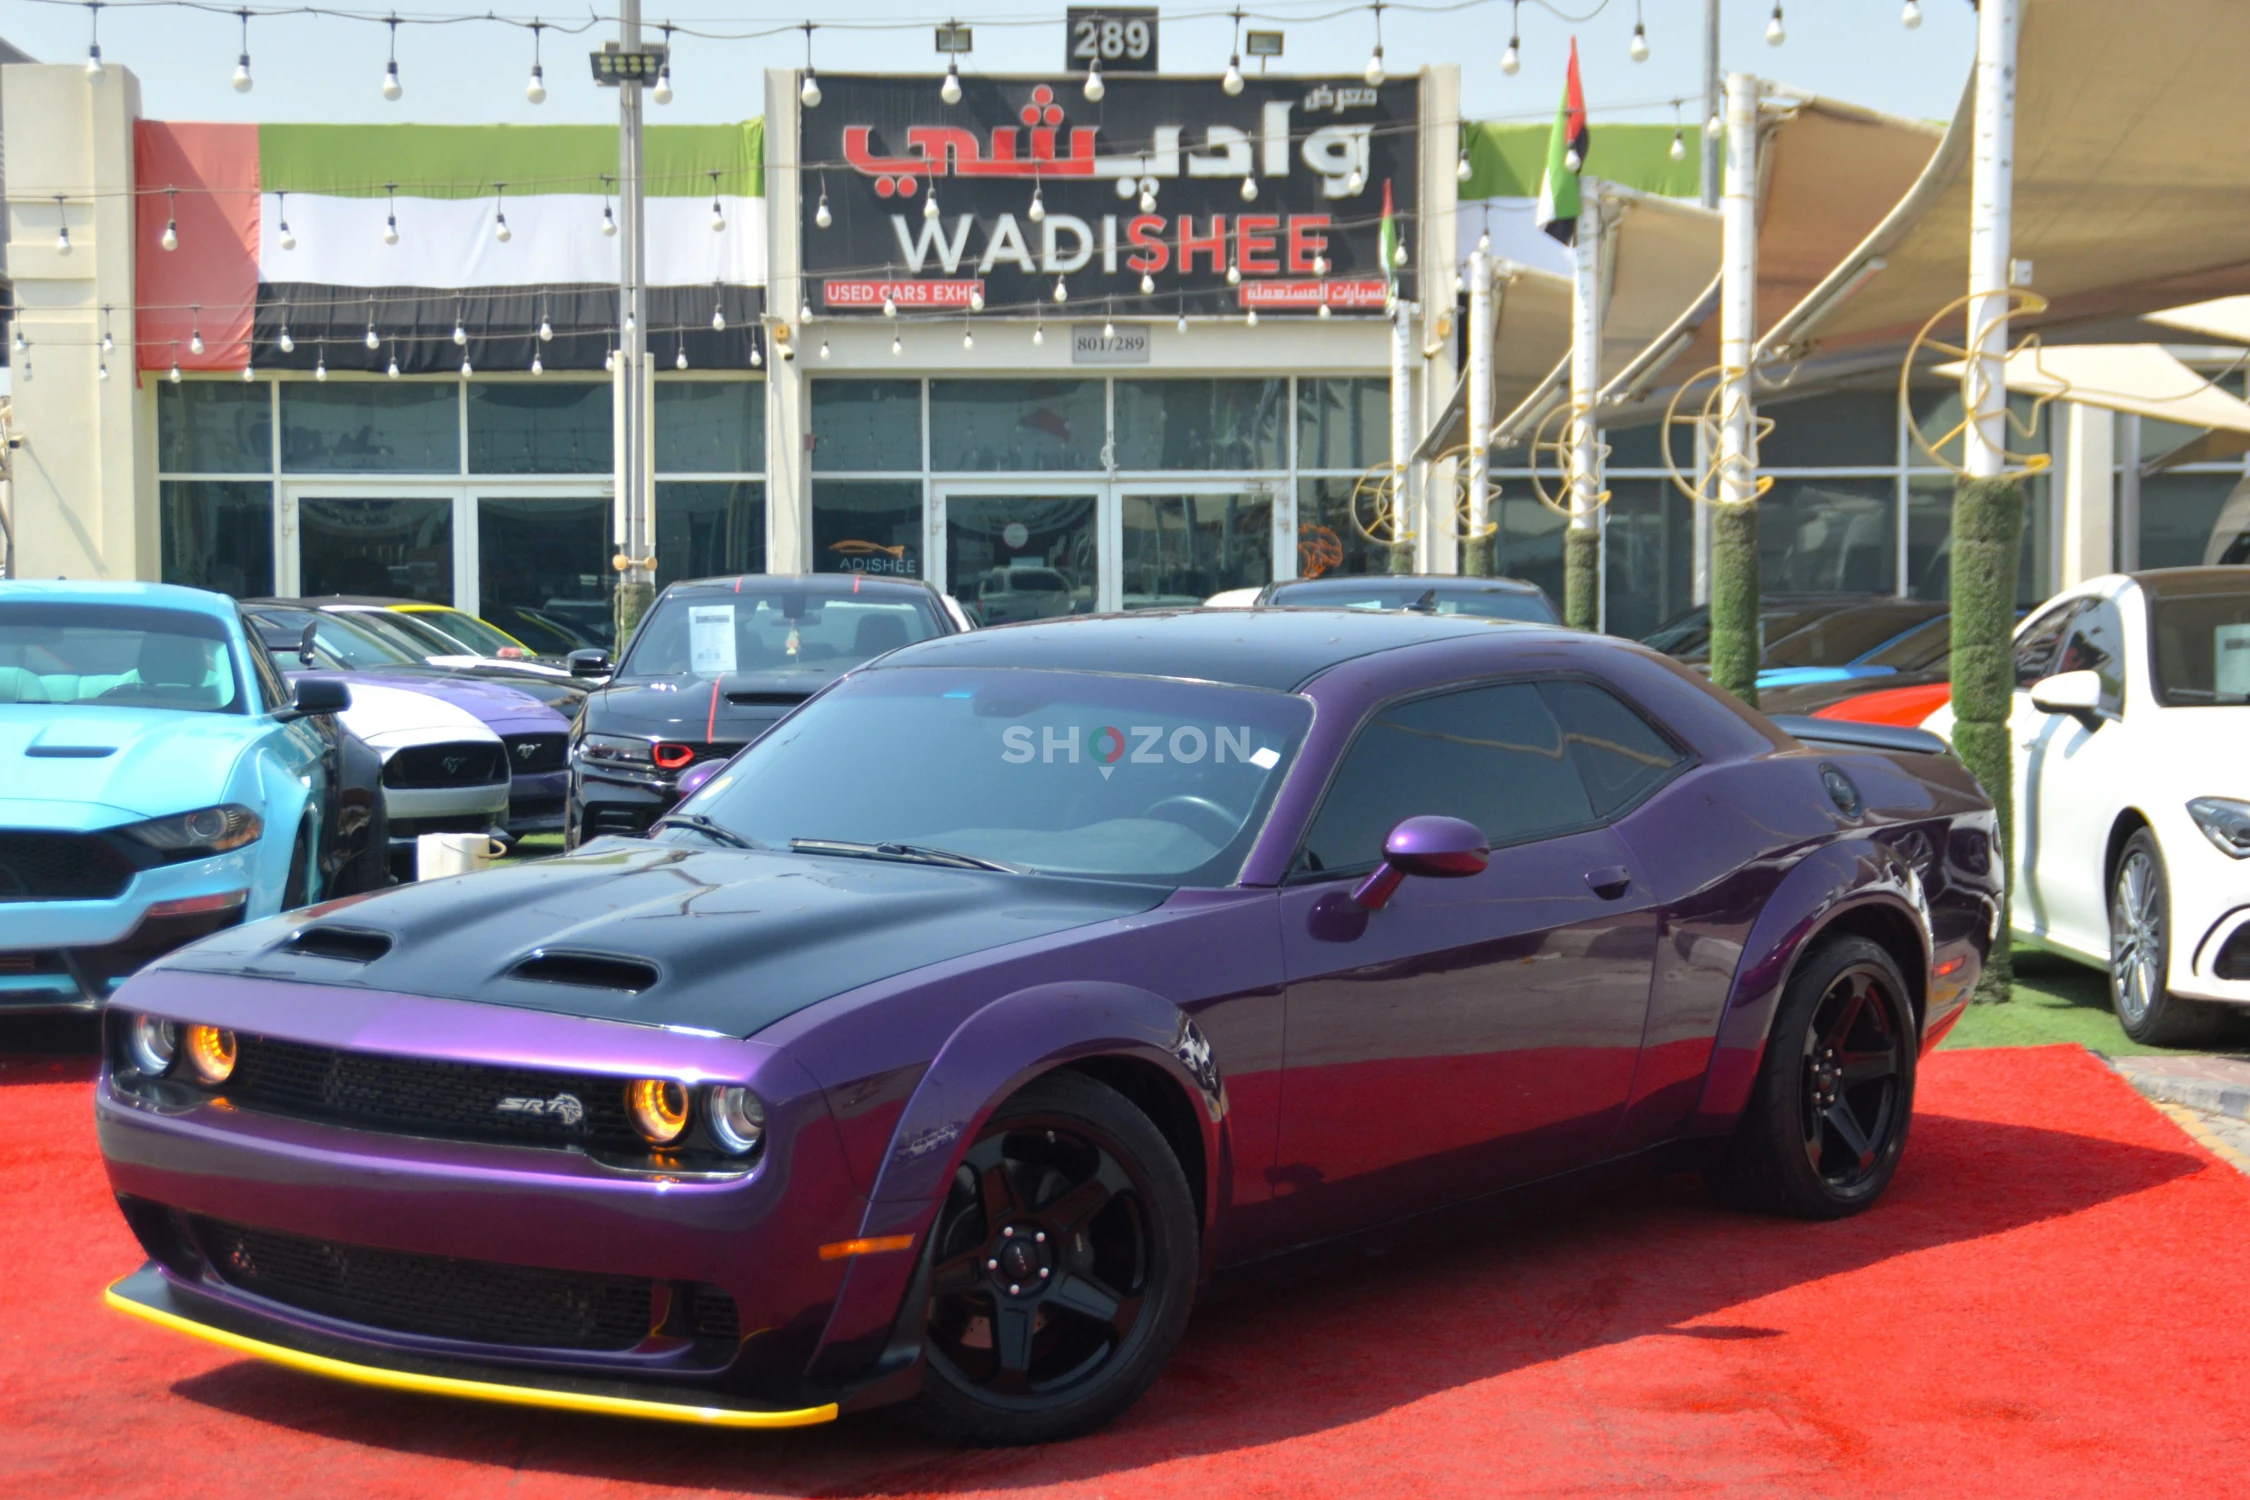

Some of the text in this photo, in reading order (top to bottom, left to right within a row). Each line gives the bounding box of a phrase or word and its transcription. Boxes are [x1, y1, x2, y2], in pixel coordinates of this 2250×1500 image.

[1074, 19, 1150, 59] 289
[1304, 84, 1377, 114] معرض
[891, 213, 1332, 274] WADISHEE
[828, 285, 874, 301] USED
[879, 285, 927, 301] CARS
[1247, 282, 1388, 306] لسيارات المستعملة
[1077, 336, 1145, 352] 801/289
[840, 557, 917, 574] ADISHEE
[497, 1097, 564, 1115] SRT
